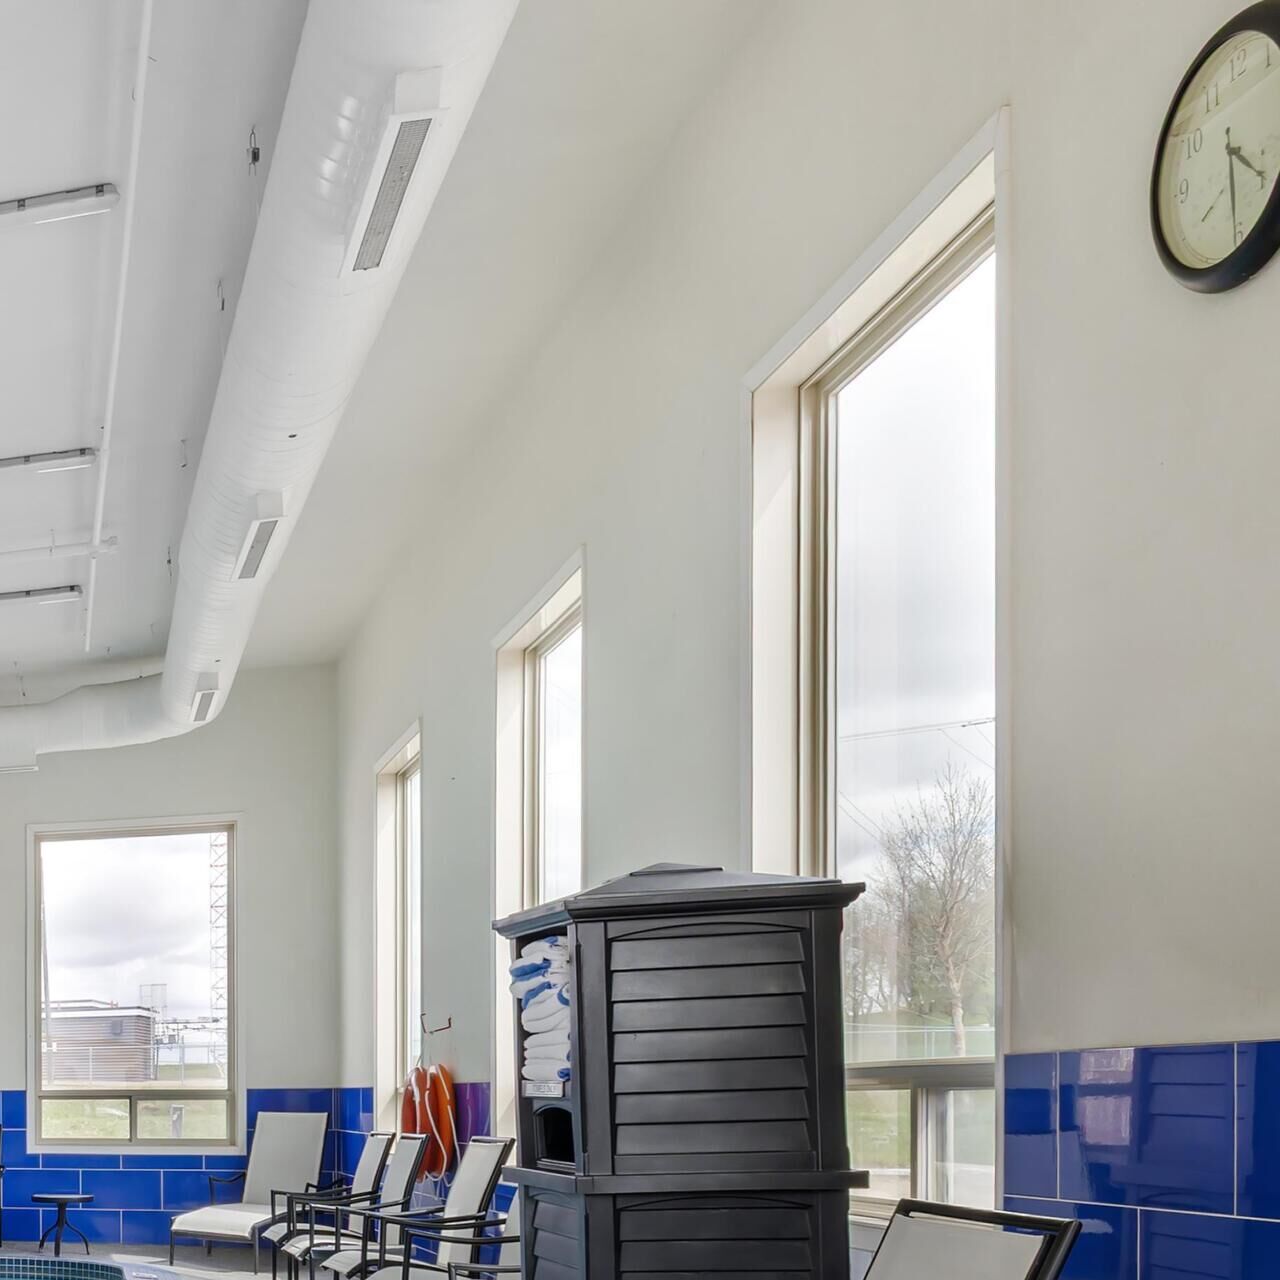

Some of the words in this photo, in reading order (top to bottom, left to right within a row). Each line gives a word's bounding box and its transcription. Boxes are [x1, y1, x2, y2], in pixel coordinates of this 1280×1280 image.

[1229, 48, 1247, 83] 12
[1205, 82, 1221, 114] 11
[1185, 127, 1203, 160] 10
[1179, 178, 1189, 204] 9
